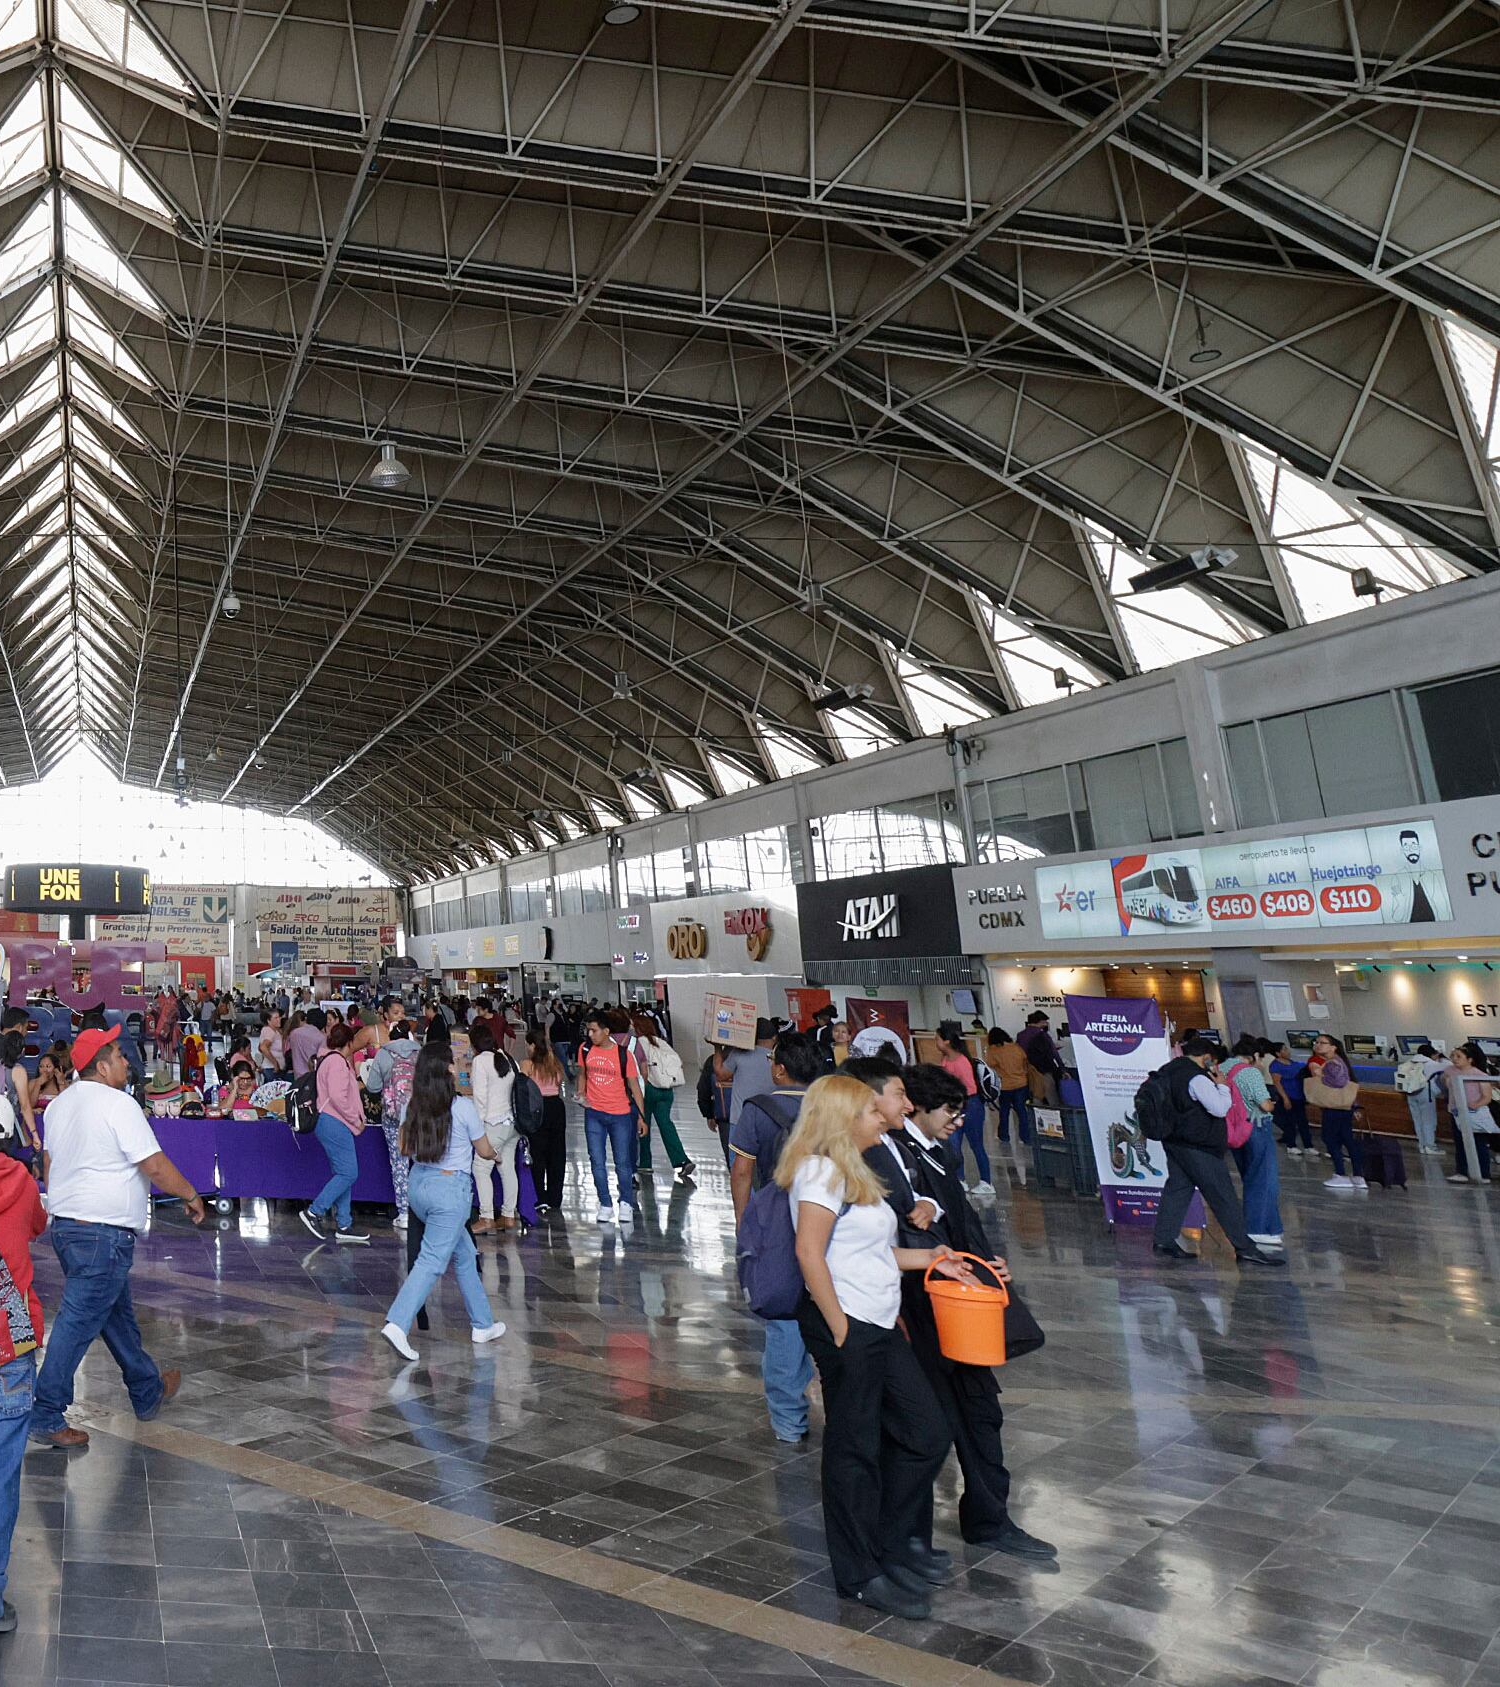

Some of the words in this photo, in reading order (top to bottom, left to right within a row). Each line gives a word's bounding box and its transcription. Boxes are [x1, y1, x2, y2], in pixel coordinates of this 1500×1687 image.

[39, 868, 81, 885] UNE
[1267, 871, 1297, 885] AICM
[1310, 864, 1383, 883] Huejotzingo
[1214, 876, 1241, 890] AIFA
[39, 884, 82, 901] FON
[967, 884, 1028, 906] PUEBLA
[1328, 888, 1372, 912] $110
[1211, 897, 1253, 919] $460
[1265, 892, 1311, 916] $408
[102, 921, 136, 933] Gracias
[154, 925, 167, 933] su
[166, 924, 221, 935] Preferencia
[978, 910, 1025, 930] CDMX
[269, 923, 302, 936] Salida
[304, 925, 318, 936] de
[320, 925, 379, 938] Autobuses
[667, 923, 706, 960] ORO
[1101, 1013, 1128, 1023] FERIA
[1084, 1022, 1146, 1034] ARTESANAL
